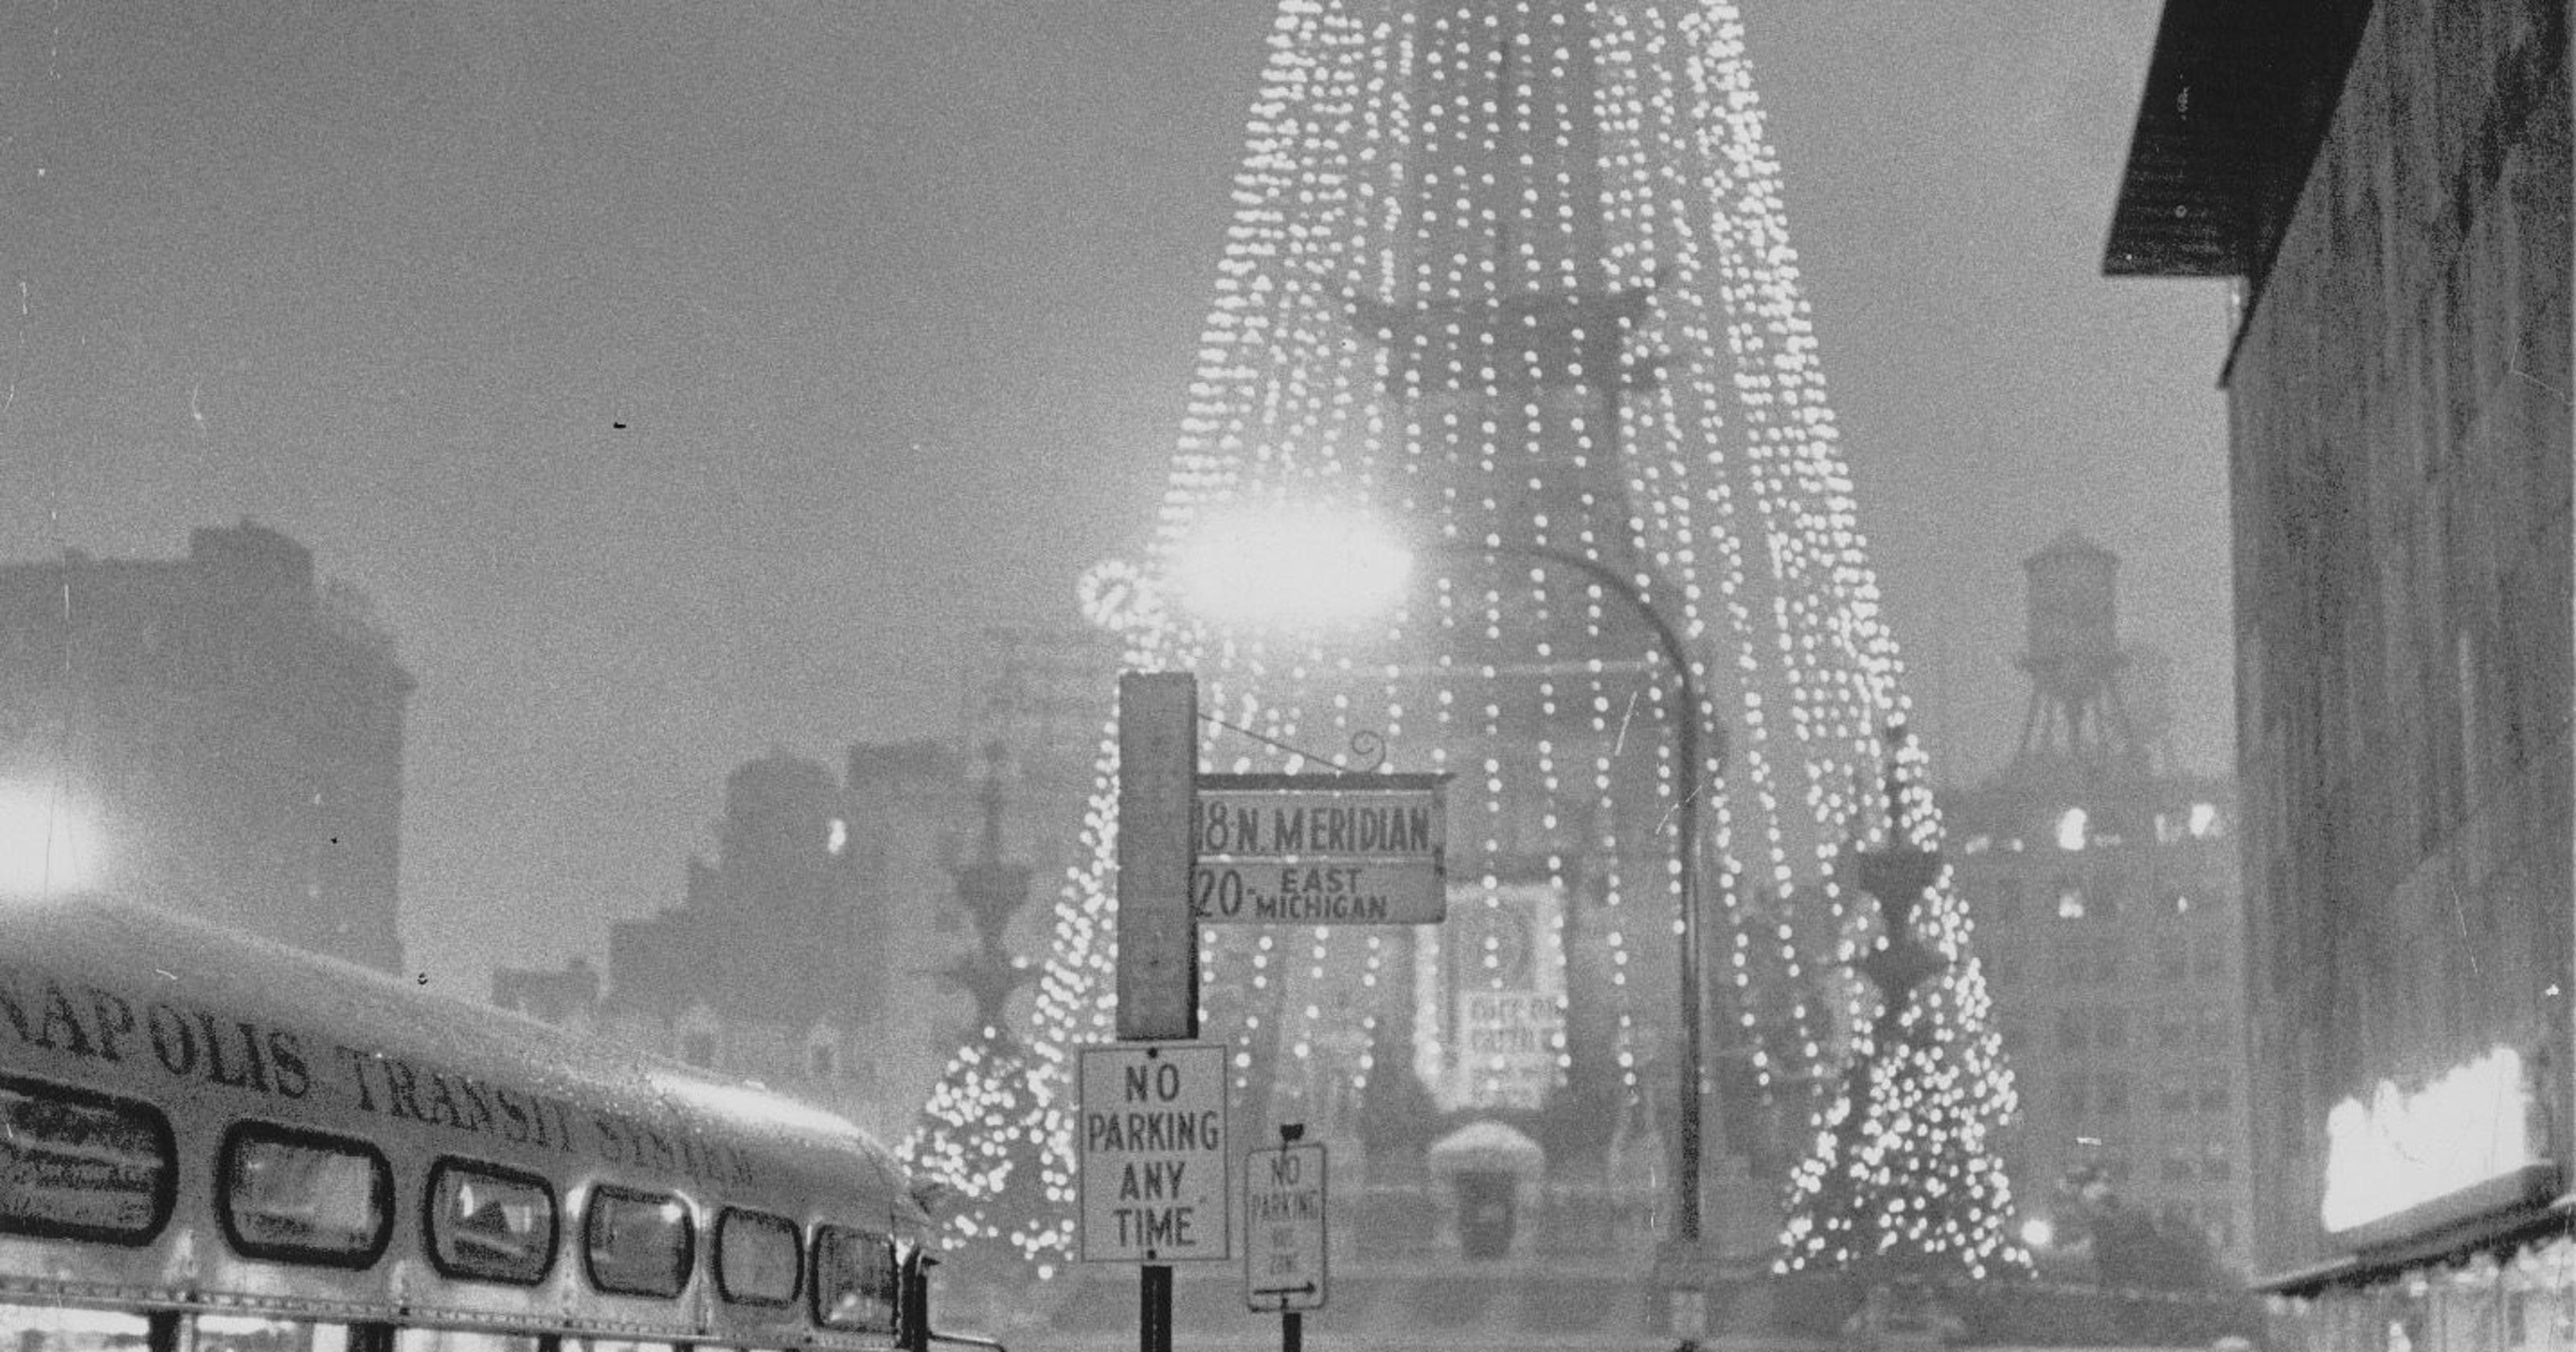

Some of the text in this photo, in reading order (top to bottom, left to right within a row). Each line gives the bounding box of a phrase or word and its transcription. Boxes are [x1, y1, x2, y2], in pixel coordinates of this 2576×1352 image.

[1275, 806, 1429, 852] MERIDIAN
[1281, 868, 1362, 895] EAST
[1255, 894, 1388, 919] MICHIGAN
[336, 1043, 576, 1153] TRANSIT
[1125, 1063, 1179, 1103] NO
[1088, 1110, 1219, 1152] PARKING
[1119, 1161, 1186, 1202] ANY
[1271, 1155, 1300, 1186] NO
[1112, 1206, 1196, 1247] TIME
